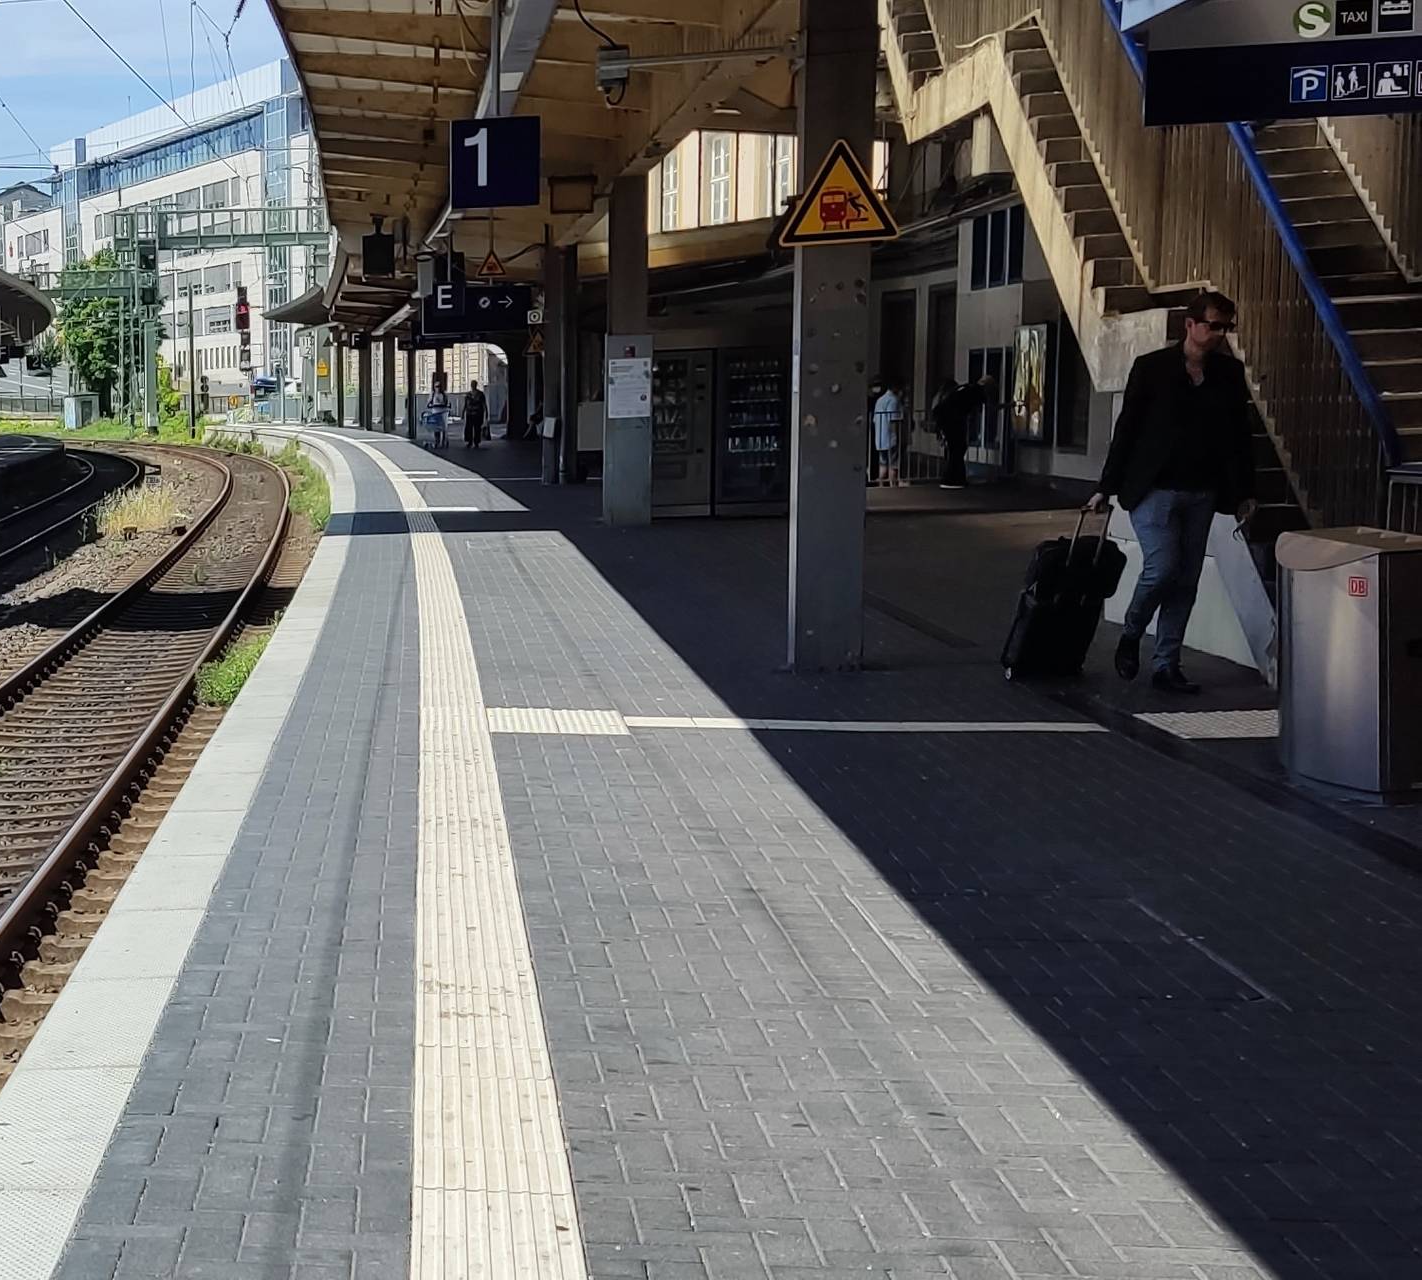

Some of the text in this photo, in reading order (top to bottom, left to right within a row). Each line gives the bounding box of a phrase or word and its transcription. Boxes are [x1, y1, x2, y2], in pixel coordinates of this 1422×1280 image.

[1298, 3, 1330, 38] S
[1340, 11, 1368, 24] TAXI
[1301, 76, 1319, 100] P
[464, 127, 488, 187] 1
[437, 284, 454, 309] E
[352, 333, 360, 346] F
[33, 356, 42, 368] 2
[1350, 578, 1366, 595] DB
